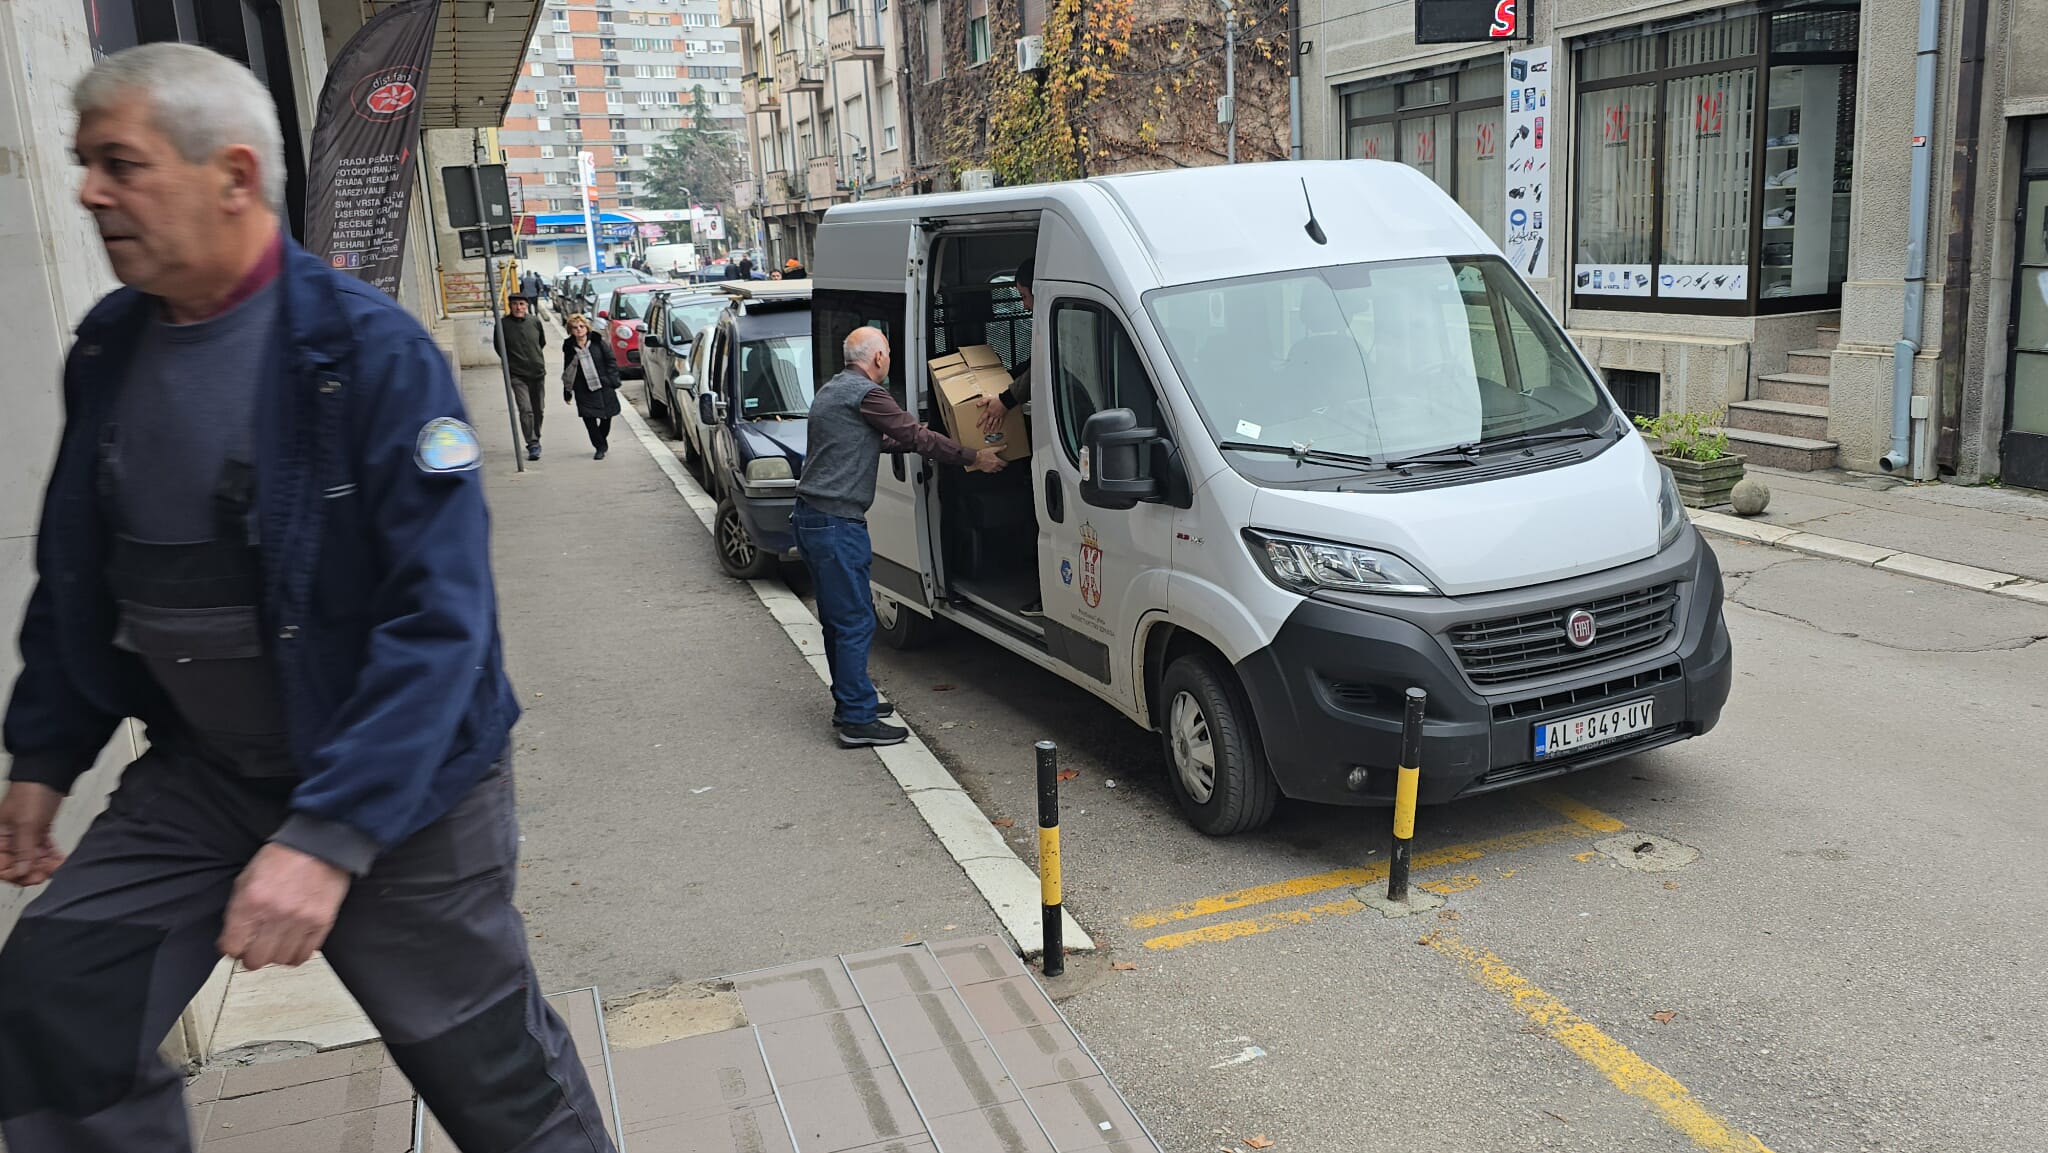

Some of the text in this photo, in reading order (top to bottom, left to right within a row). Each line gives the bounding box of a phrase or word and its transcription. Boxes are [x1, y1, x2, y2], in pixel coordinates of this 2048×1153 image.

[334, 177, 363, 187] IZRADA
[335, 186, 387, 197] NAREZIVANJE
[356, 198, 381, 207] VRSTA
[334, 208, 374, 219] LASERSKO
[333, 240, 365, 249] PEHARI
[1574, 619, 1590, 638] FIAT
[1549, 724, 1571, 749] AL
